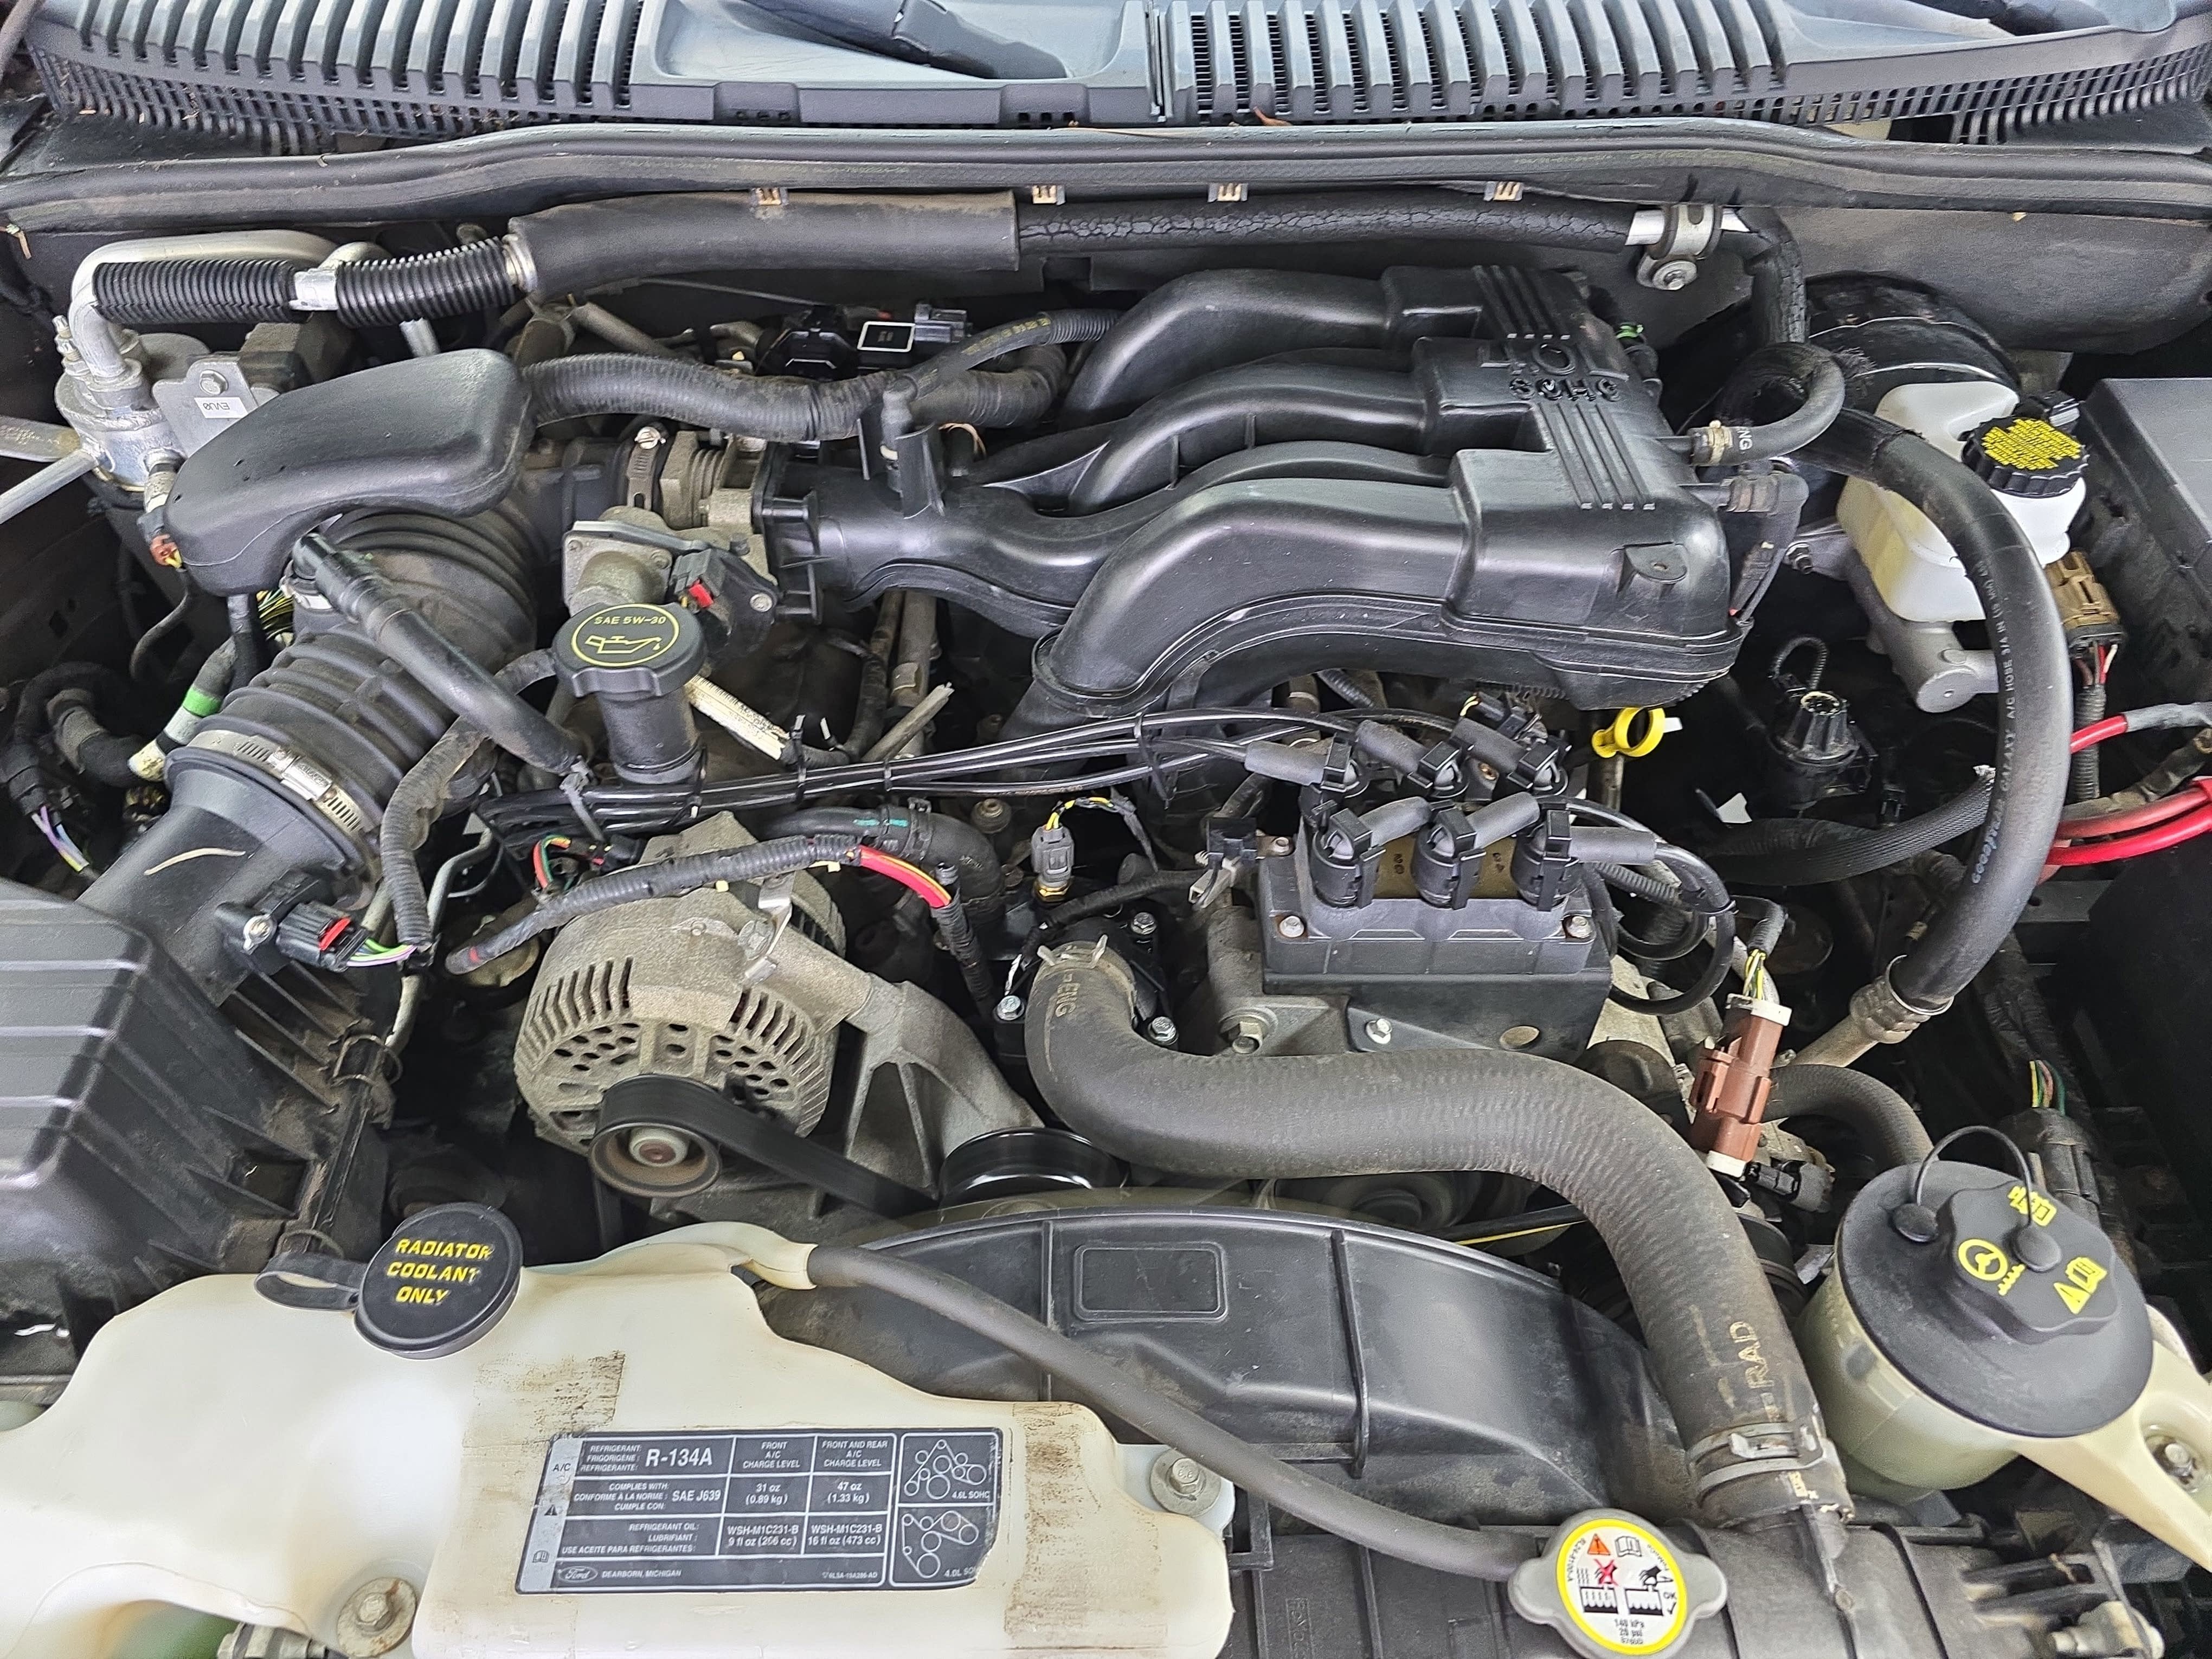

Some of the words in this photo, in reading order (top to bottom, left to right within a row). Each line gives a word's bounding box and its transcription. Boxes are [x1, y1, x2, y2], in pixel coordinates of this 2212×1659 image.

[1737, 426, 1753, 451] NG
[594, 616, 619, 625] SAE
[622, 616, 667, 625] 5W-30
[395, 1238, 495, 1261] RADIATOR
[387, 1261, 481, 1284] COOLANT
[395, 1285, 451, 1305] ONLY
[1729, 1321, 1774, 1389] RAD
[761, 1441, 788, 1450] FRONT
[821, 1441, 848, 1449] FRONT
[866, 1440, 889, 1448] REAR
[645, 1447, 713, 1468] R-134A
[765, 1450, 781, 1459] A/C
[846, 1450, 863, 1458] A/C
[553, 1463, 570, 1471] A/C
[743, 1459, 776, 1469] CHARGE
[777, 1459, 800, 1468] LEVEL
[824, 1459, 857, 1468] CHARGE
[858, 1458, 882, 1467] LEVEL
[609, 1483, 648, 1491] COMPLIES
[756, 1483, 767, 1492] 31
[837, 1481, 848, 1490] 47
[850, 1483, 863, 1491] oz
[574, 1493, 617, 1501] CONFORME
[672, 1490, 695, 1501] SAE
[696, 1490, 721, 1501] J639
[827, 1493, 851, 1504] (1.33
[853, 1493, 870, 1504] kg)
[968, 1490, 991, 1499] SOHC
[745, 1494, 769, 1505] (0.89
[770, 1494, 788, 1506] kg)
[614, 1502, 646, 1510] CUMPLE
[629, 1523, 683, 1532] REFRIGERANT
[684, 1522, 699, 1531] OIL:
[727, 1524, 800, 1535] WSH-M1C231-B
[811, 1523, 883, 1535] WSH-M1C231-B
[648, 1533, 693, 1542] LUBRIFIANT
[736, 1536, 744, 1546] fl
[745, 1538, 757, 1547] oz
[781, 1535, 798, 1547] cc)
[808, 1535, 820, 1545] 16
[821, 1535, 828, 1545] fl
[829, 1537, 841, 1545] oz
[842, 1534, 863, 1546] (473
[864, 1534, 882, 1546] cc)
[562, 1546, 577, 1554] USE
[578, 1545, 606, 1554] ACEITE
[607, 1545, 628, 1553] PARA
[602, 1570, 645, 1579] DEARBORN,
[645, 1570, 681, 1578] MICHIGAN
[944, 1568, 962, 1577] 4.0L
[1663, 1591, 1677, 1600] OK
